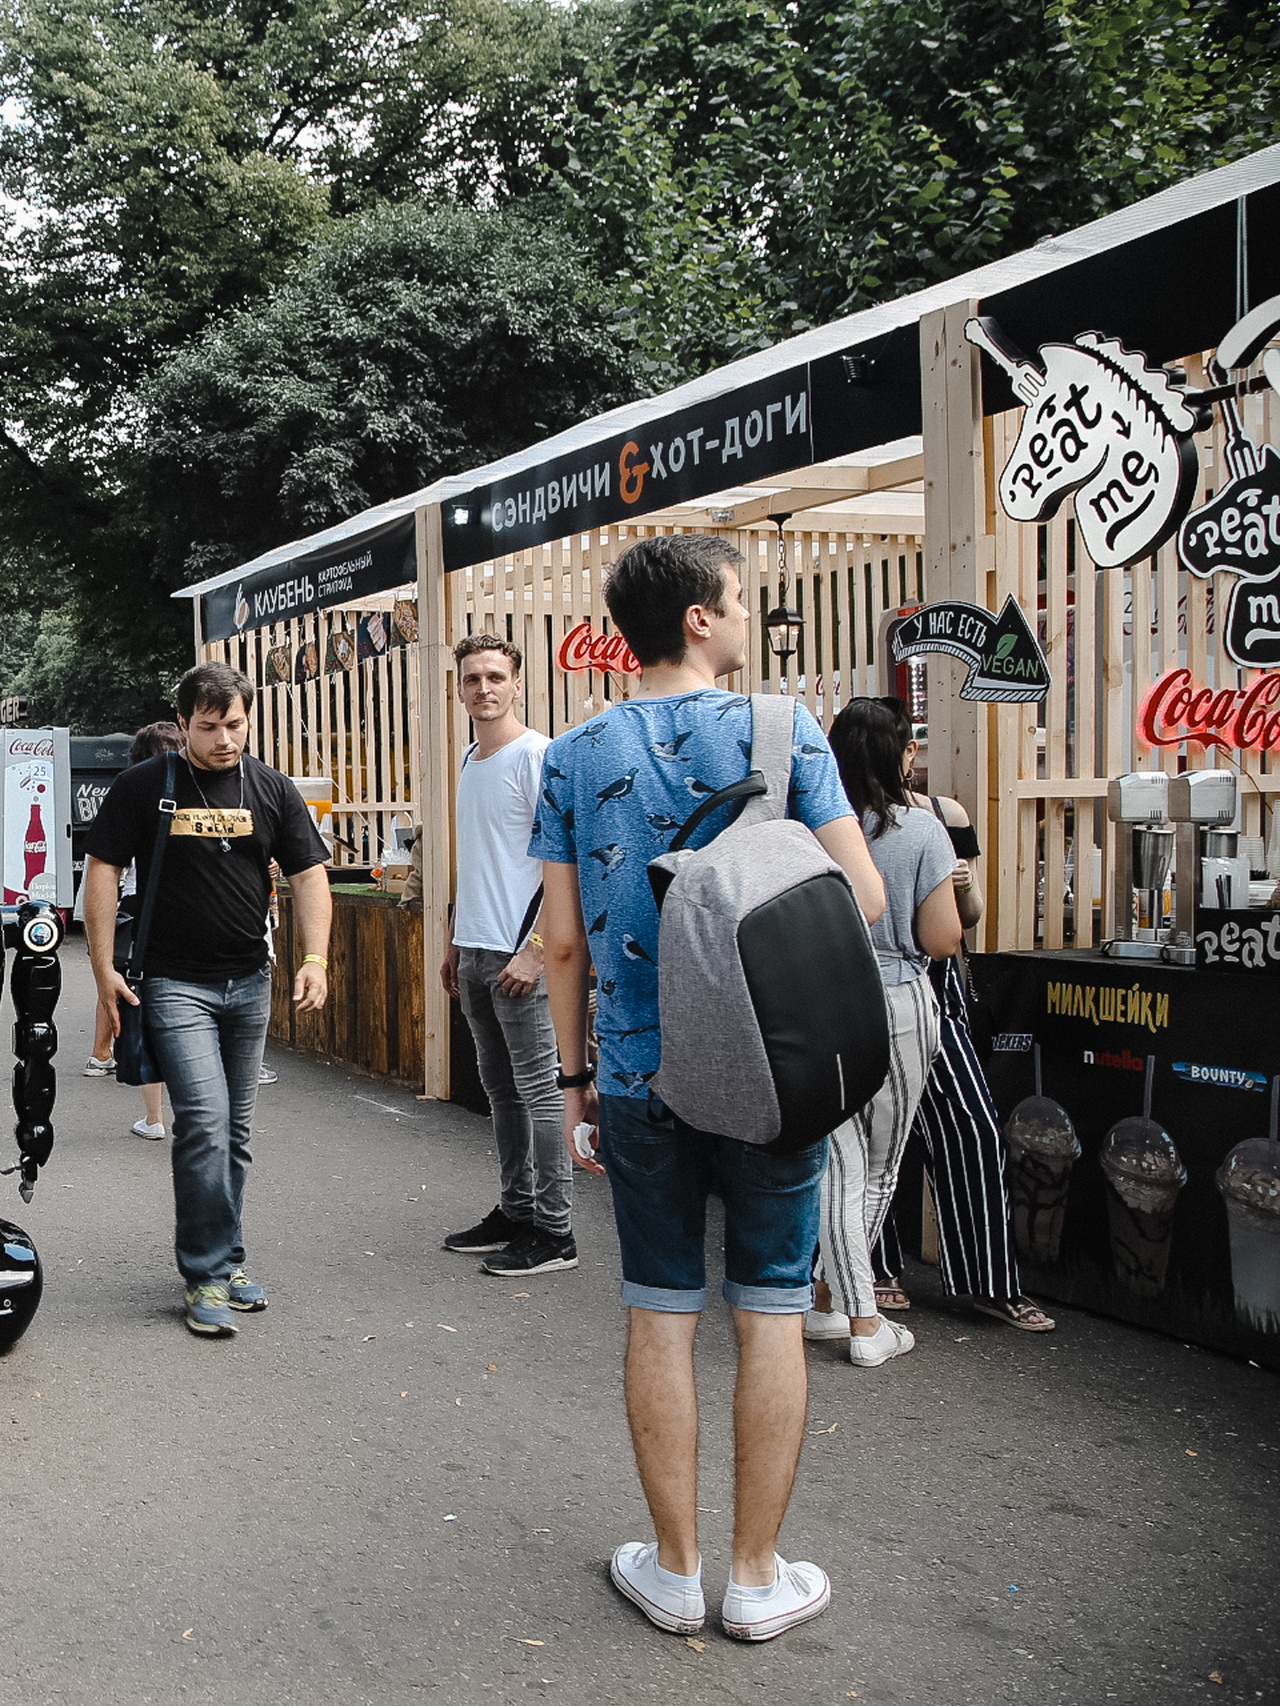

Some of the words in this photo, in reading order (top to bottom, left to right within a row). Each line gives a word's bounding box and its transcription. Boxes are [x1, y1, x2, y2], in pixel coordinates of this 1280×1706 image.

[491, 461, 611, 533] СЭНДВИЧИ
[650, 391, 807, 480] ХОТ-ДОГИ
[1089, 451, 1159, 523] me
[318, 550, 373, 584] КАРТОФЕЛЬНЫЙ
[254, 575, 315, 618] КЛУБЕНЬ
[1248, 594, 1280, 625] m
[913, 615, 923, 639] У
[929, 611, 955, 635] НАС
[957, 613, 988, 648] ЕСТЬ
[981, 653, 1039, 679] VEGAN
[34, 766, 46, 776] 25
[1047, 981, 1169, 1034] МИЛКШЕЙКИ
[1083, 1050, 1144, 1072] nutella
[1191, 1065, 1247, 1085] BOUNTY
